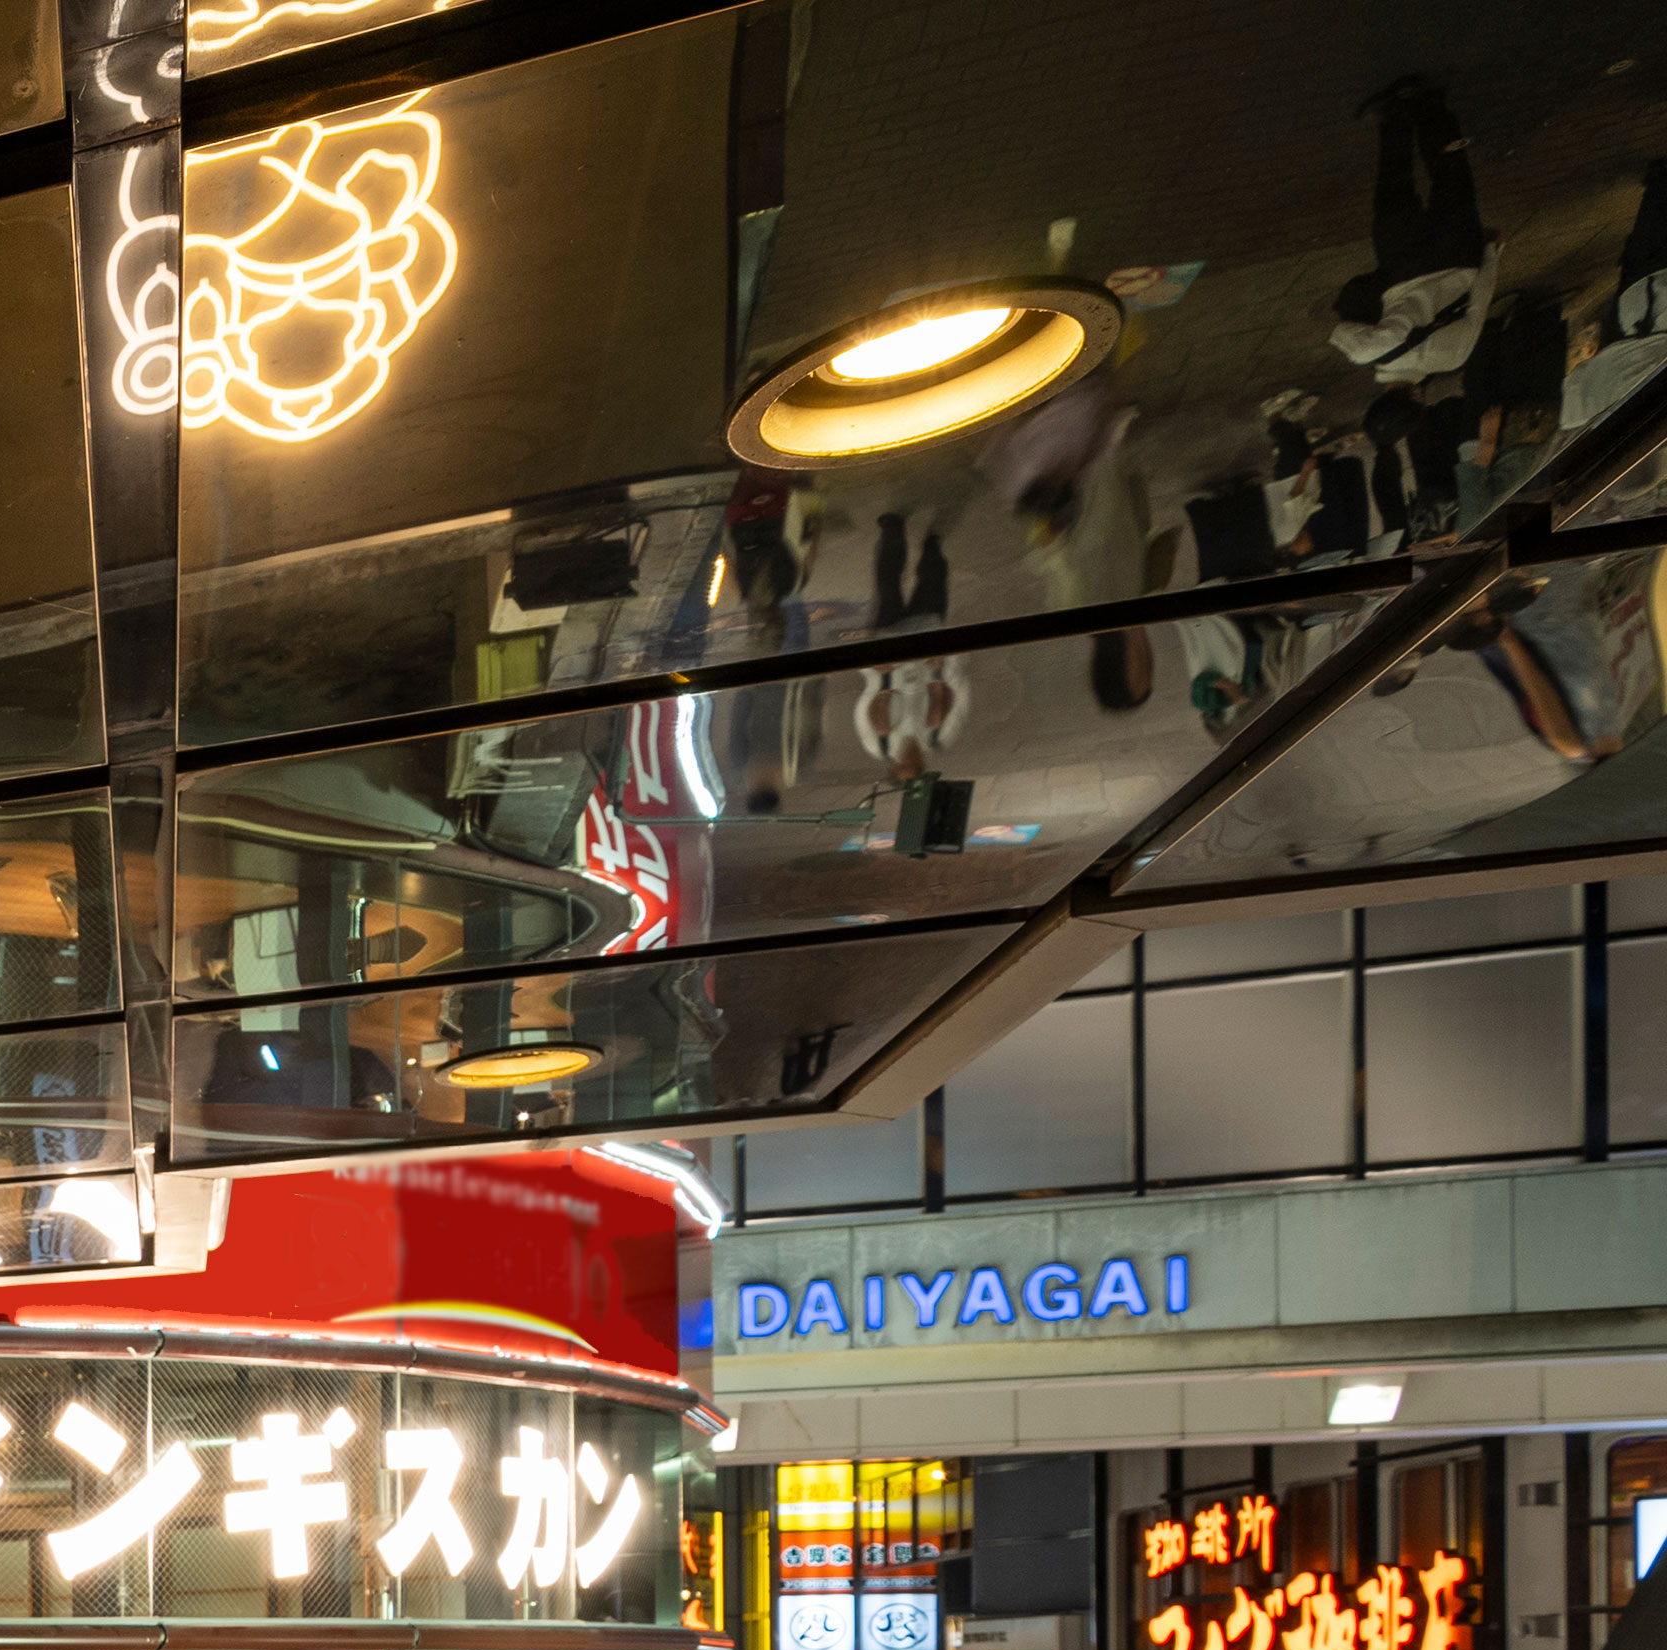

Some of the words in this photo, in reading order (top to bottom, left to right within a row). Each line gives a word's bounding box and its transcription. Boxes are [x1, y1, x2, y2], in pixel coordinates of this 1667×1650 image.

[738, 1254, 1190, 1339] DAIYAGAI
[781, 1543, 854, 1568] 吉野家
[1144, 1494, 1277, 1578] 珈琲所
